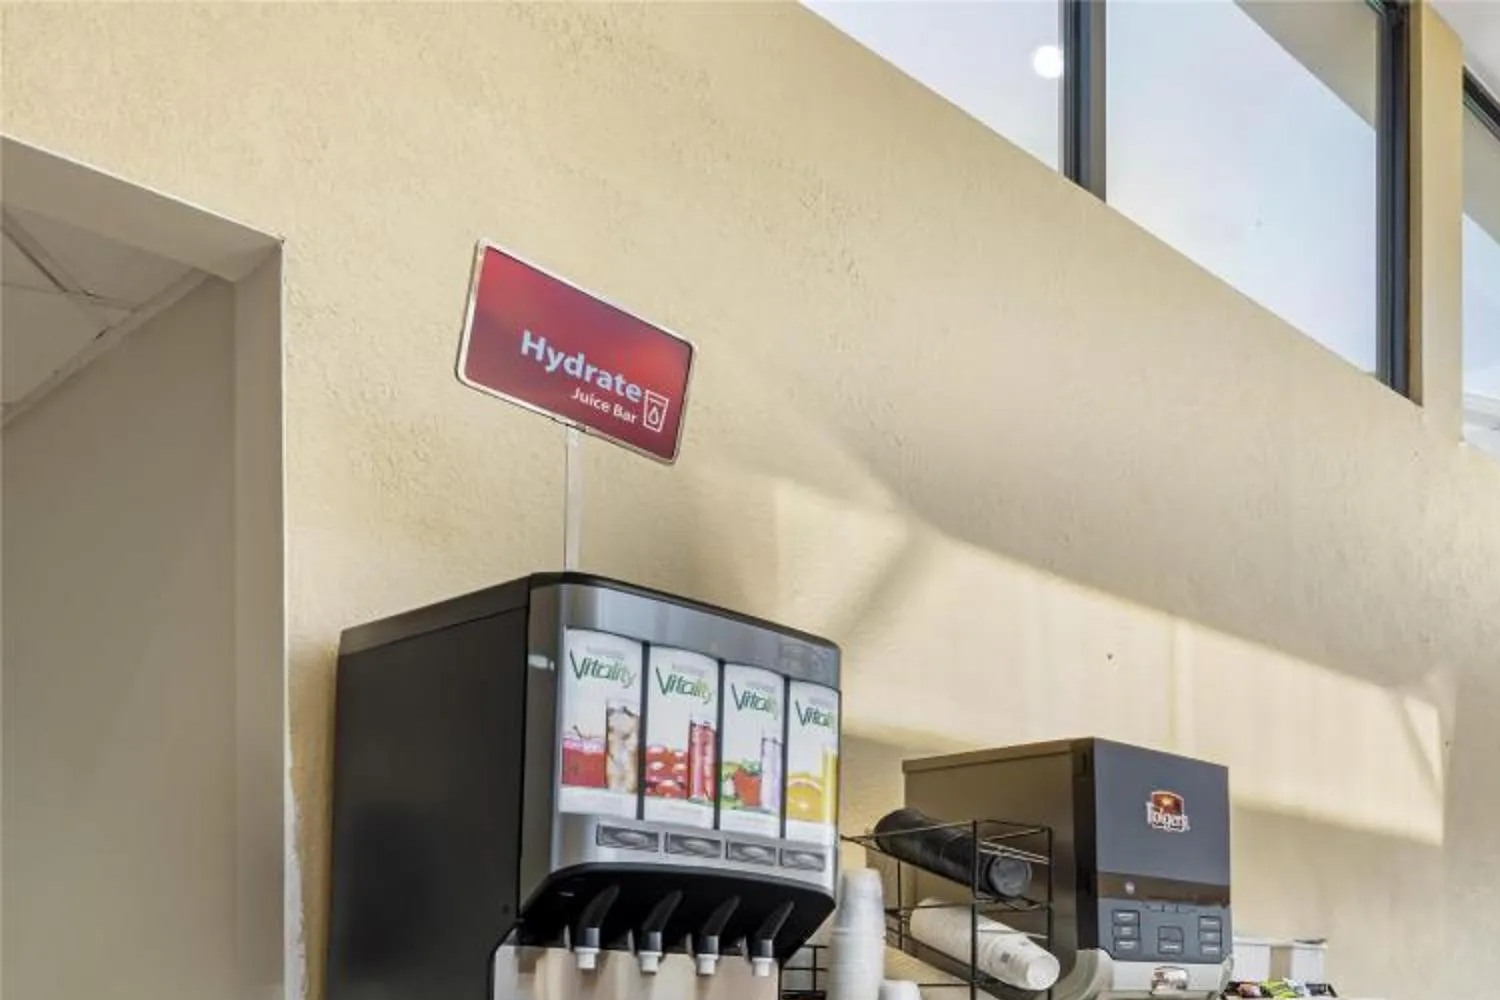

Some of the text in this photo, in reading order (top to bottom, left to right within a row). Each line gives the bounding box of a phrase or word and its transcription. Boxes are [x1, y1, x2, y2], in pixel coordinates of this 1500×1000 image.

[521, 330, 642, 402] Hydrate
[571, 387, 638, 424] Juice Bar
[569, 649, 638, 689] Vitality
